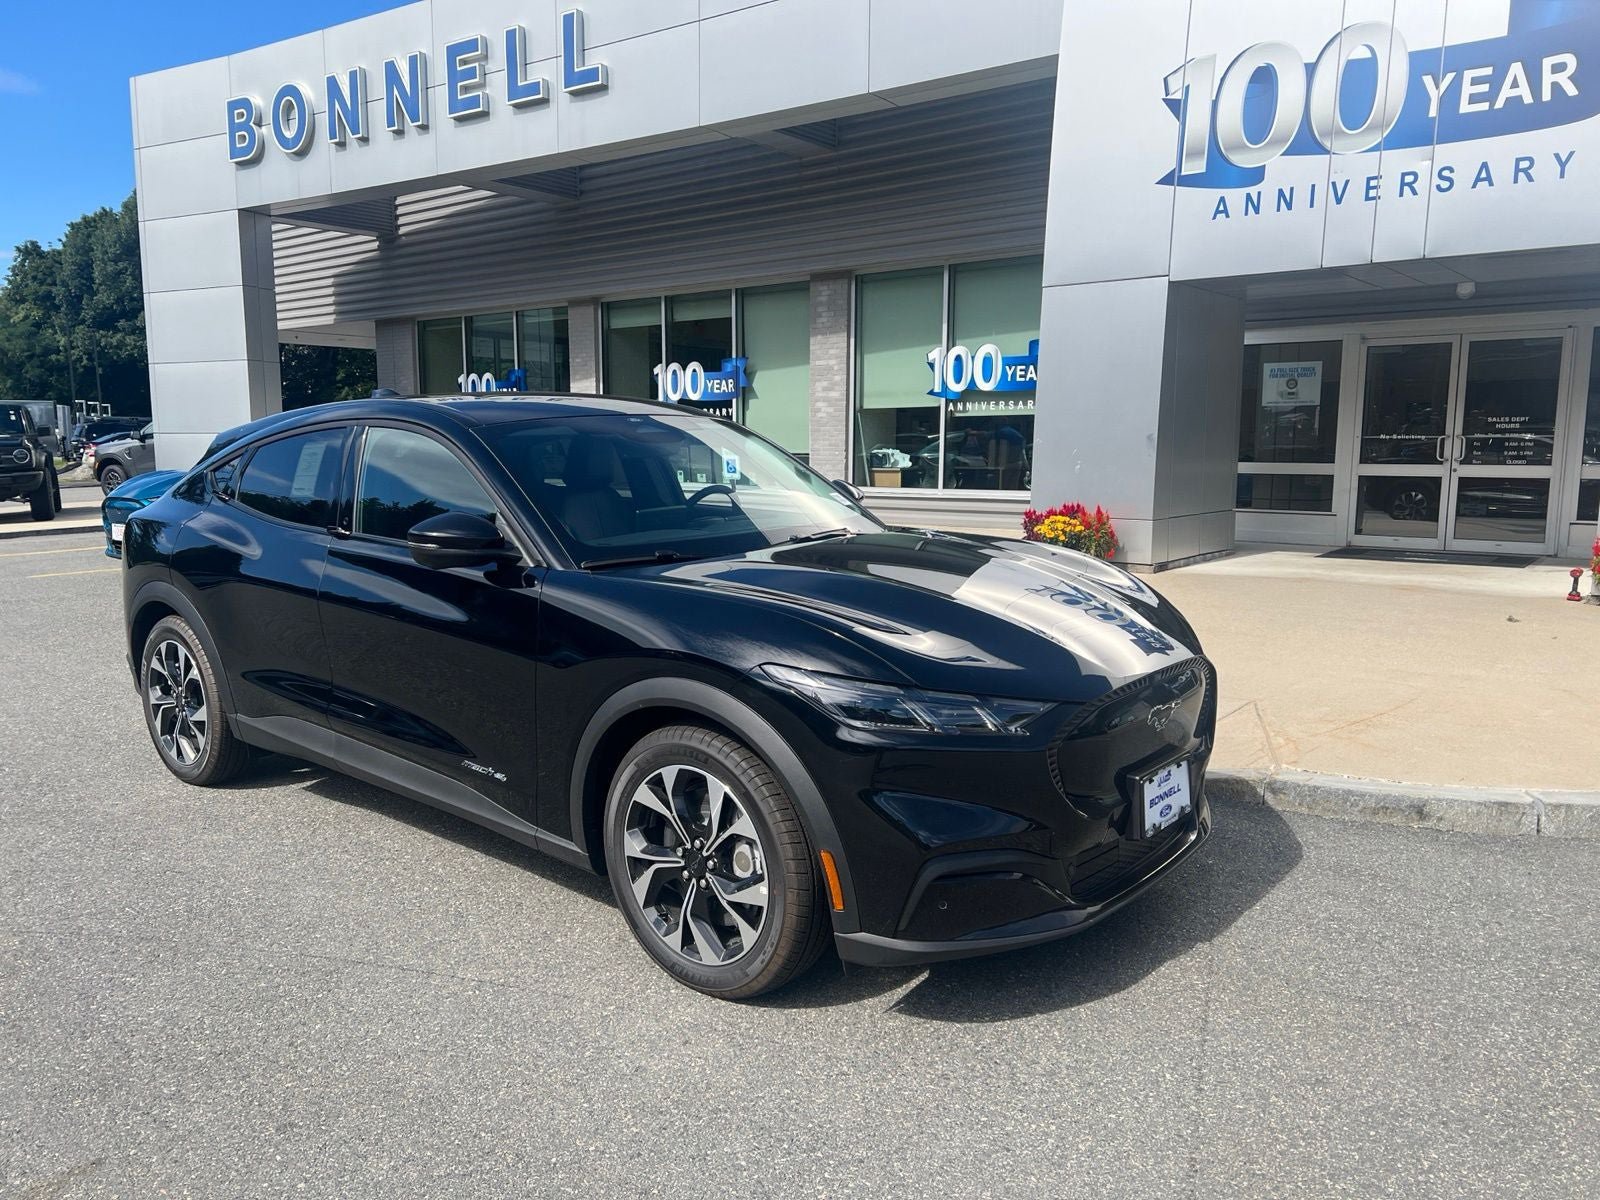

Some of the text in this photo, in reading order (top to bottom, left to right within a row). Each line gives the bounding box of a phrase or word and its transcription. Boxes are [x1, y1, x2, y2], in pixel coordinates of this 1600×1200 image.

[226, 9, 607, 163] BONNELL
[1163, 20, 1580, 176] 100 YEAR
[1211, 150, 1576, 221] ANNIVERSARY
[457, 372, 496, 392] 100
[652, 361, 735, 402] 100 YEAR
[926, 343, 1003, 393] 100
[1149, 783, 1182, 810] BONNELL
